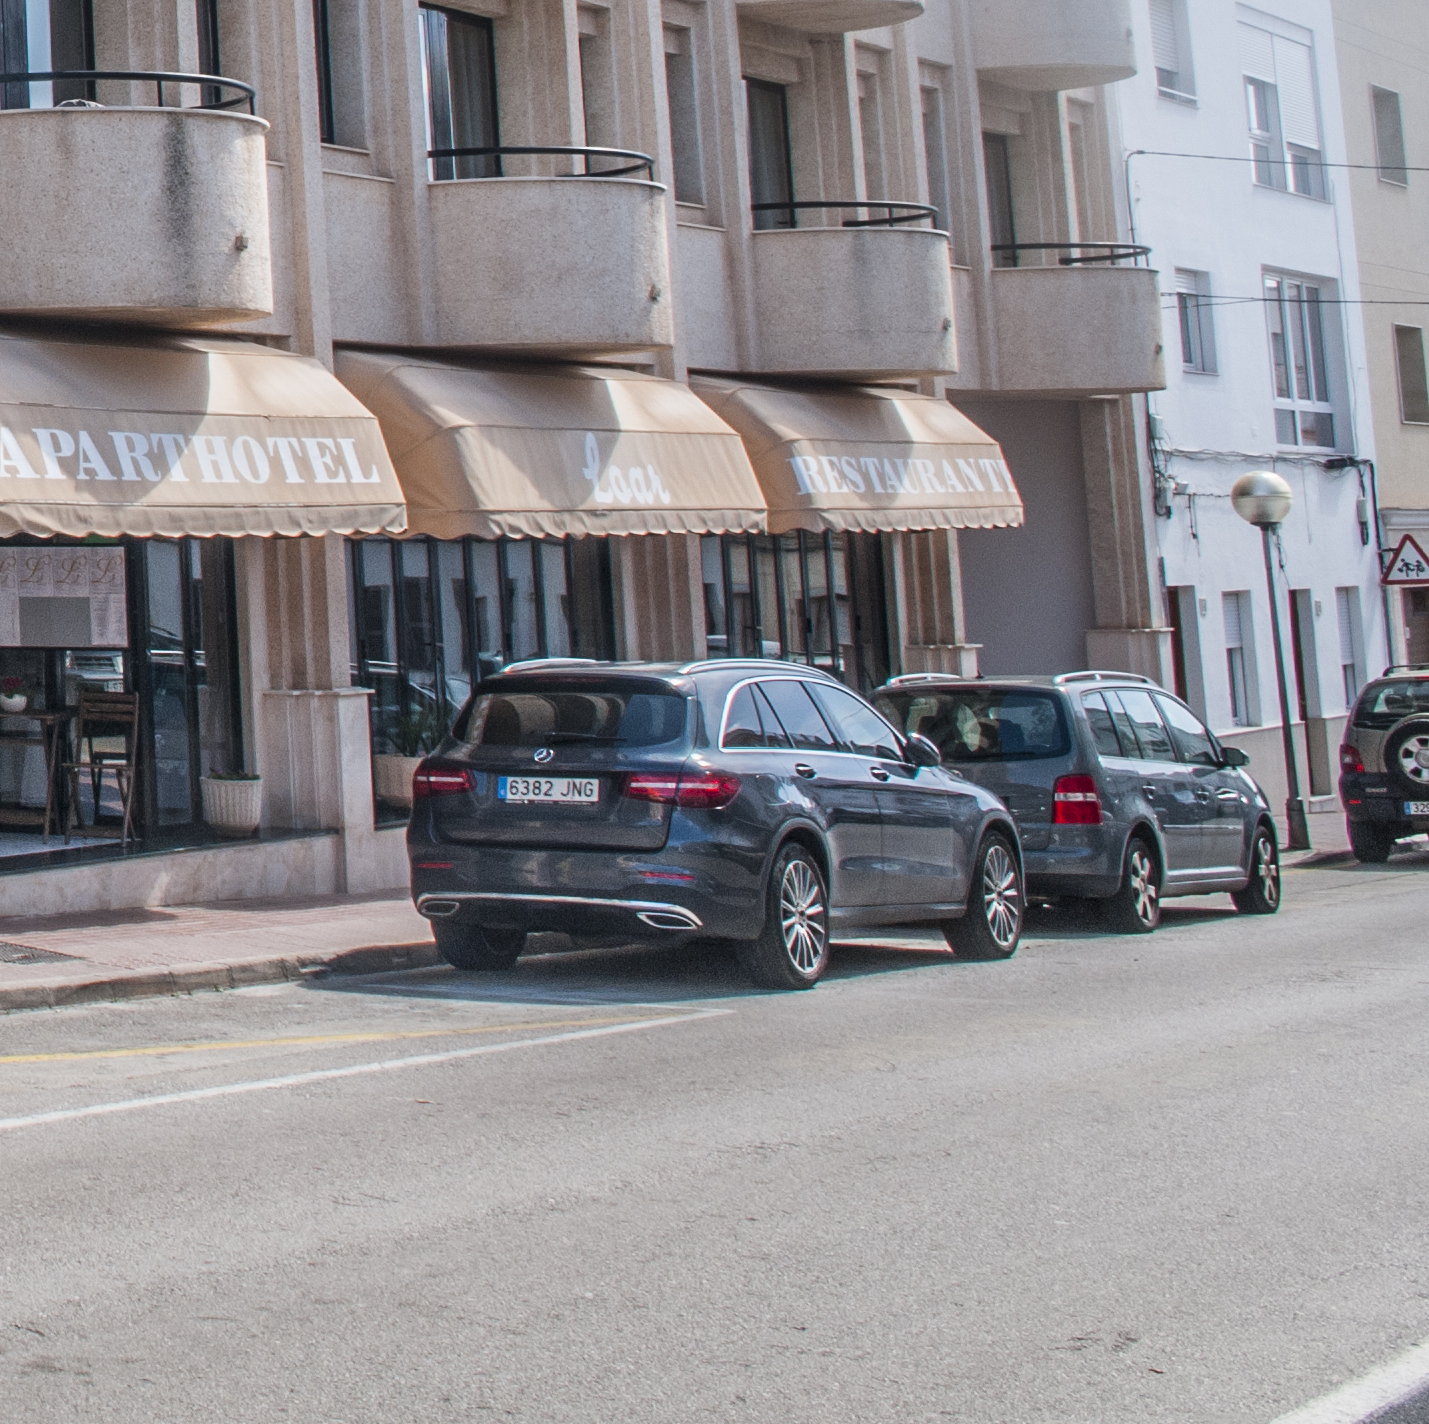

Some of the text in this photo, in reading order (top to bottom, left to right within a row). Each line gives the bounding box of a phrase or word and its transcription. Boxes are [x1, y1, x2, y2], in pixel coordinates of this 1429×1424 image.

[582, 431, 671, 505] Loar
[508, 779, 594, 798] 6382 JNG
